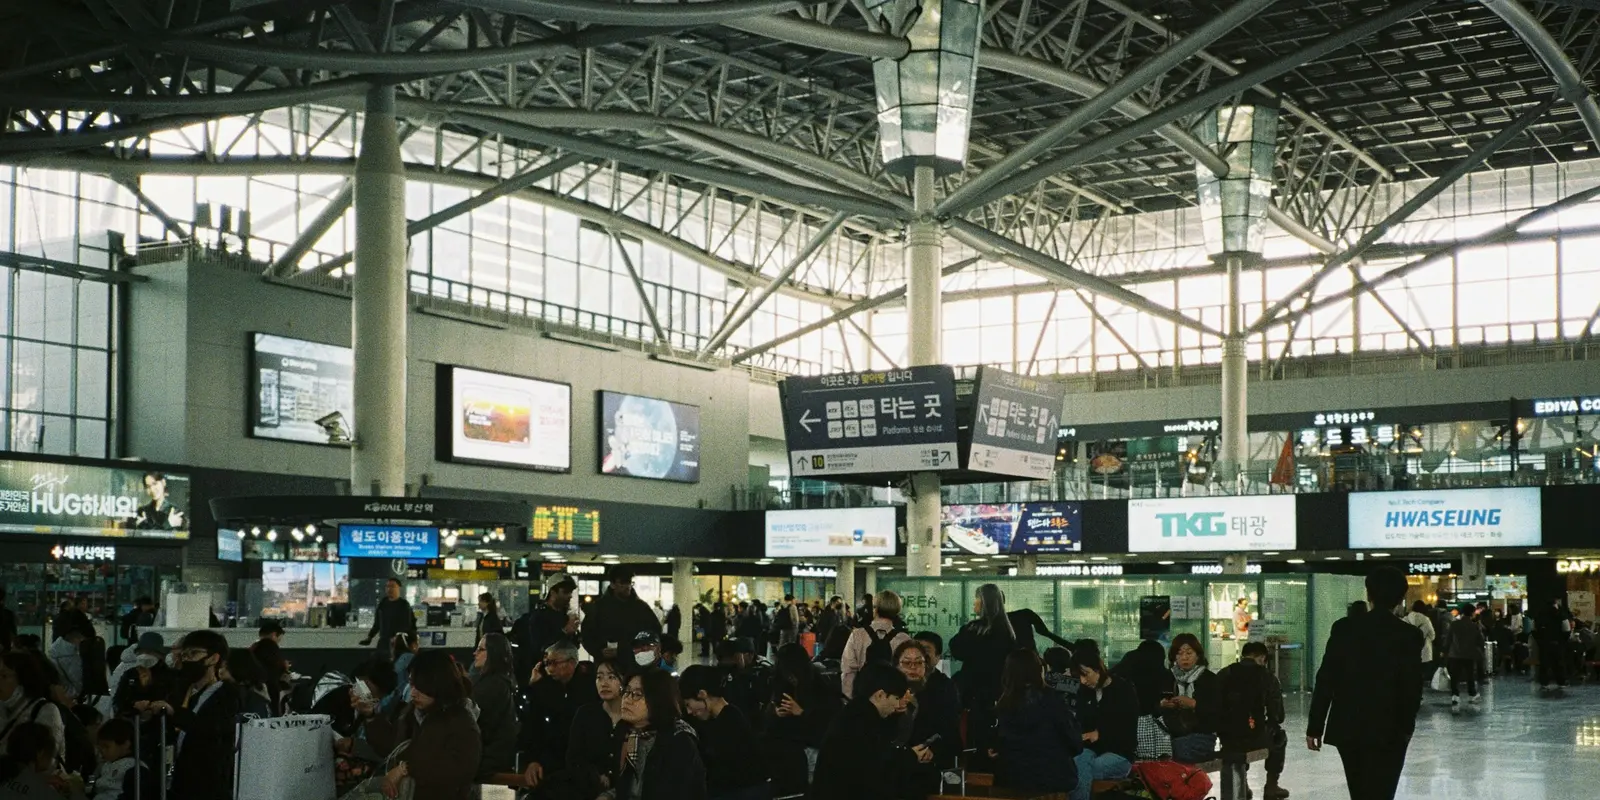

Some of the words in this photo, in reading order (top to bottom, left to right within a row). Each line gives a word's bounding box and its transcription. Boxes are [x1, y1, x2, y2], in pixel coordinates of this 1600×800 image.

[821, 375, 845, 386] 이곳은
[887, 370, 913, 382] 입니다
[880, 396, 916, 419] 타는
[924, 394, 942, 418] 곳
[1535, 400, 1579, 413] EDIYA
[882, 425, 911, 435] Platforms
[1301, 426, 1393, 446] 푸드코트
[812, 456, 824, 468] 10
[31, 491, 138, 518] HUG하세요!
[364, 503, 402, 512] KORAIL
[404, 503, 434, 513] 부산역
[1155, 512, 1227, 537] TKG
[1231, 516, 1268, 537] 태광
[1385, 508, 1502, 528] HWASEUNG
[351, 529, 429, 544] 철도이용안내
[1091, 566, 1123, 575] COFFEE
[1191, 565, 1223, 574] KAKAO
